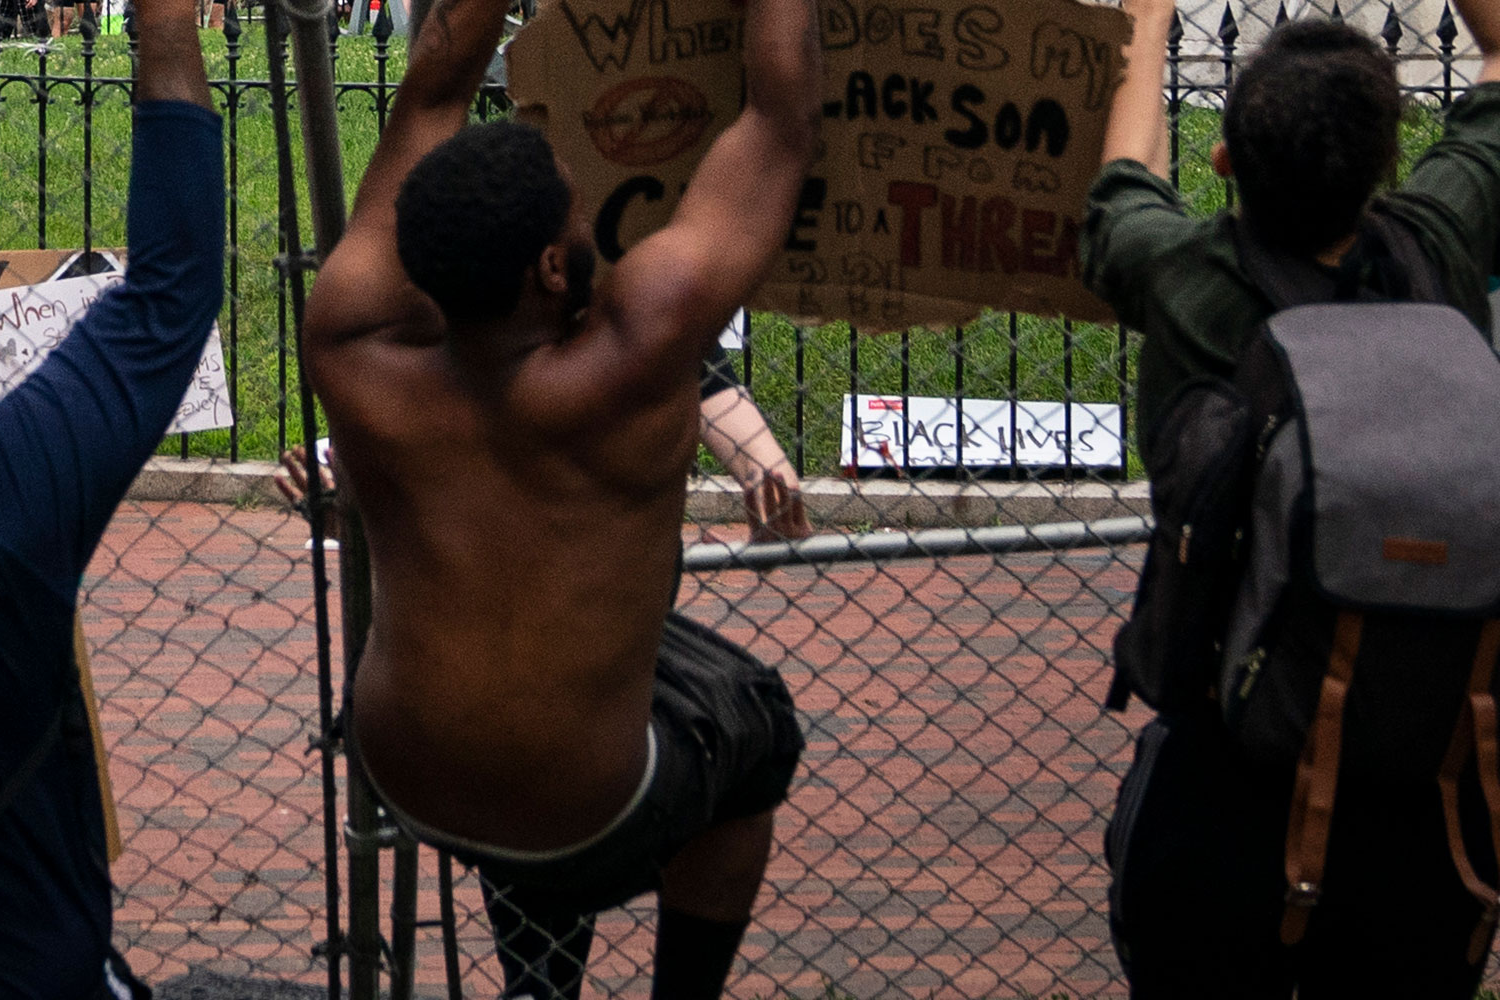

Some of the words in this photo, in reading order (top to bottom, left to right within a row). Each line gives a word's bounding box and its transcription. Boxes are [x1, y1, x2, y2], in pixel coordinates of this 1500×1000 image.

[593, 175, 828, 261] CE
[832, 199, 865, 235] TO
[873, 208, 892, 235] A
[887, 180, 1081, 278] THREA
[856, 416, 982, 452] BLACK
[998, 425, 1095, 452] LIVES
